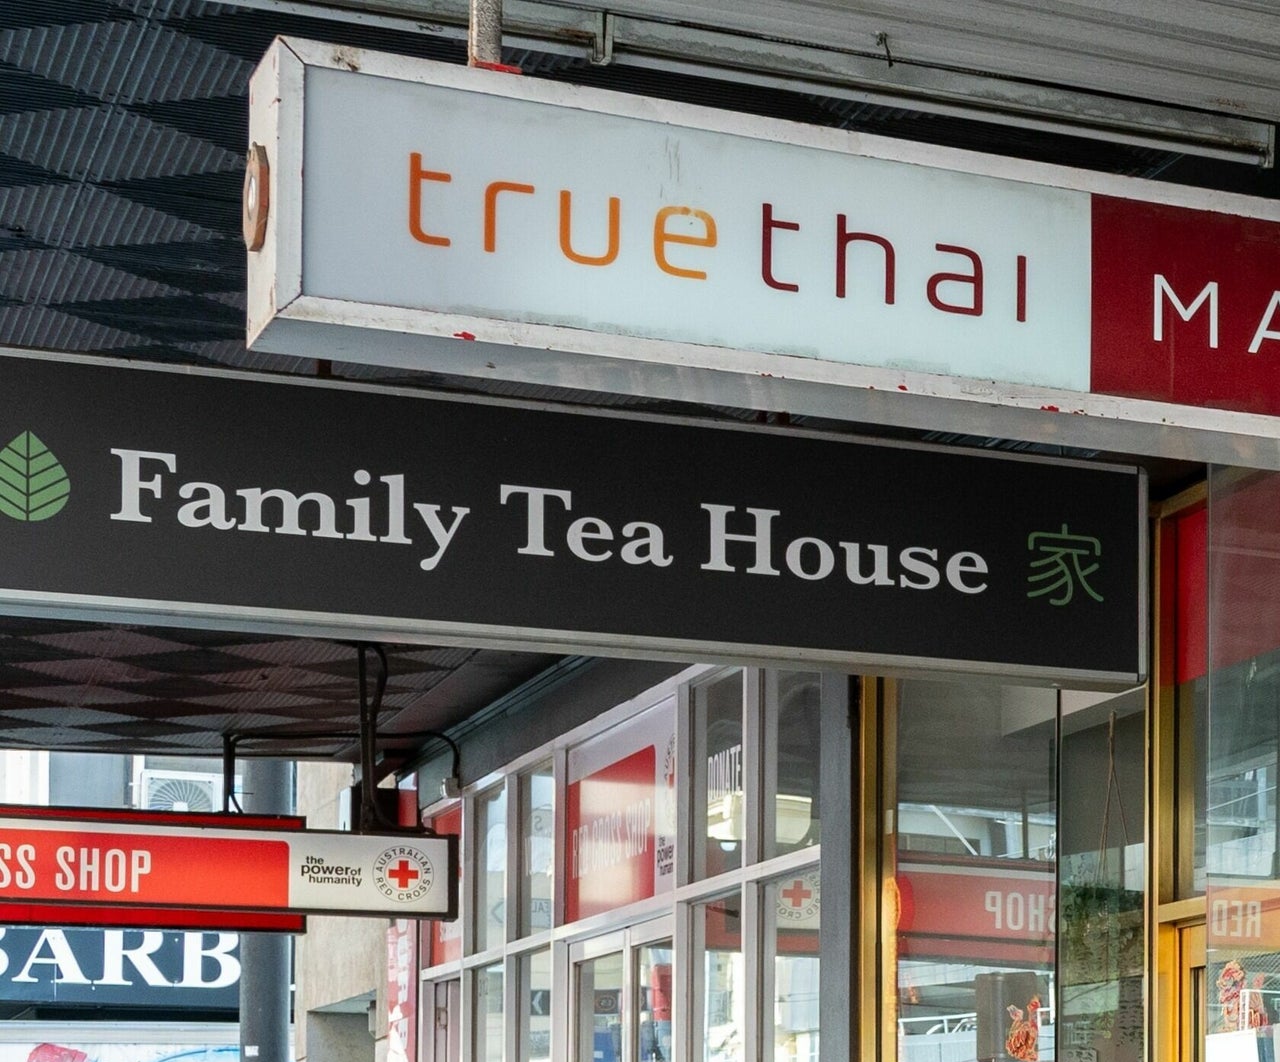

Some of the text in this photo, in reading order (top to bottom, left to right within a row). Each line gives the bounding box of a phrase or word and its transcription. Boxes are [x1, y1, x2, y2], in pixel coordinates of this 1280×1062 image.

[408, 151, 718, 281] true
[110, 448, 989, 596] Family Tea House
[1026, 523, 1105, 607] 家
[708, 744, 741, 800] DONATE
[55, 846, 152, 893] SHOP
[305, 856, 324, 865] the
[308, 874, 362, 887] humanity
[376, 847, 431, 874] AUSTRALIAN
[376, 876, 431, 900] RED CROSS
[0, 929, 241, 988] ARB
